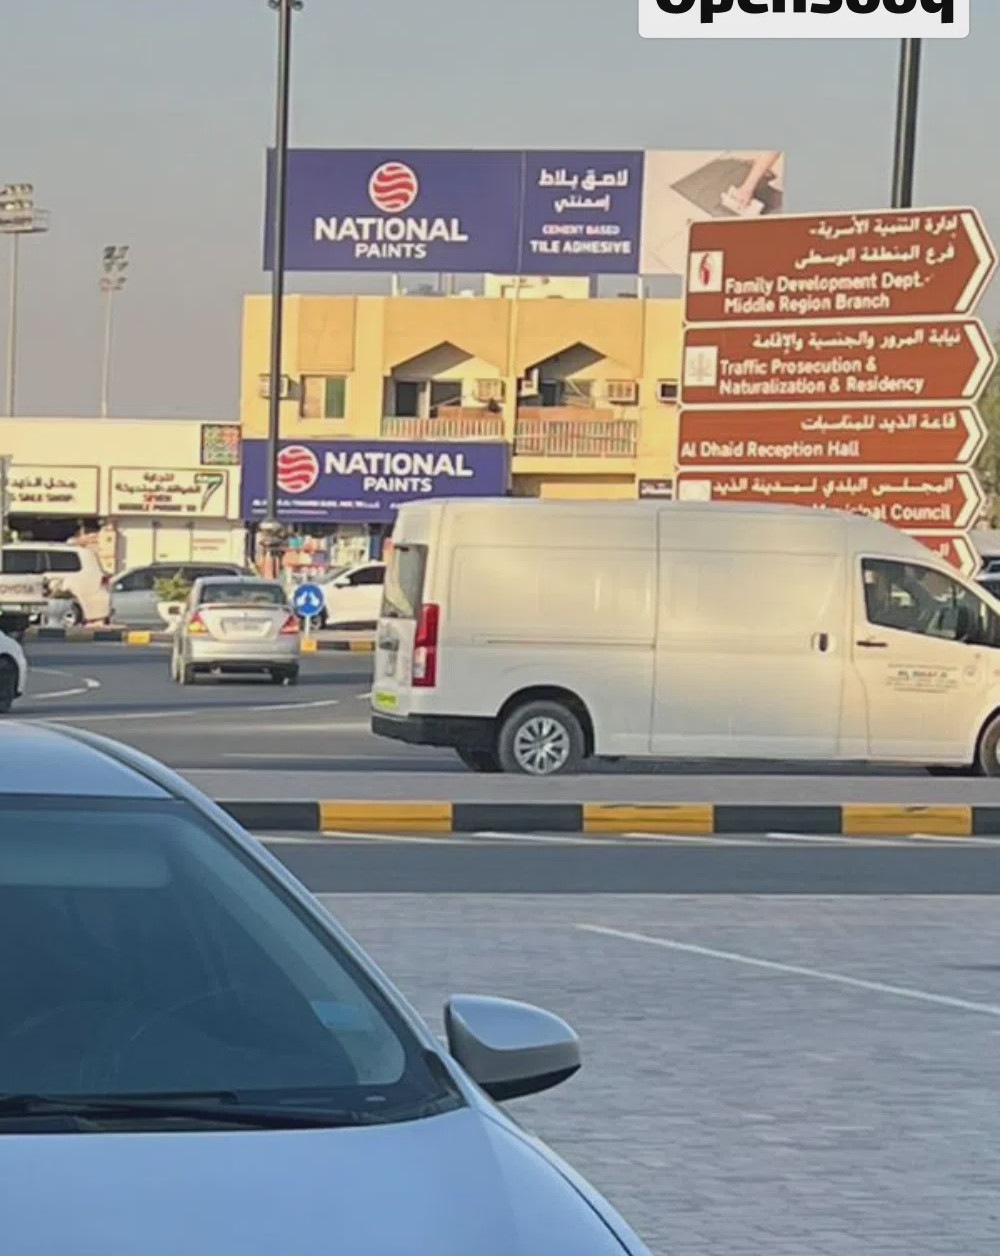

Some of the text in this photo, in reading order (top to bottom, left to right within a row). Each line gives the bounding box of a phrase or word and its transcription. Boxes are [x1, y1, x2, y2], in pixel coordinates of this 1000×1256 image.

[538, 168, 628, 190] لاصق بلاط
[315, 217, 468, 242] NATIONAL
[874, 217, 920, 237] التنمية
[924, 215, 957, 238] إدارة
[355, 242, 427, 259] PAINTS
[530, 240, 631, 254] TILE ADHESIVE
[860, 245, 920, 261] المنطقة
[925, 243, 954, 264] فرع
[725, 277, 774, 295] Family
[777, 272, 878, 293] Development
[724, 293, 889, 314] Middle Region Branch
[809, 331, 874, 349] والجنسية
[880, 329, 923, 349] المرور
[928, 329, 961, 347] نيابة
[720, 355, 877, 375] Traffic Prosecution &
[719, 375, 924, 395] Naturalization & Residency
[800, 412, 957, 433] قاعة الذيد للمناسبات
[681, 440, 859, 459] Al Dhaid Reception Hall
[324, 452, 473, 477] NATIONAL
[363, 477, 432, 492] PAINTS
[713, 477, 748, 496] الذيد
[823, 477, 868, 497] البلدي
[872, 477, 953, 494] المجلس
[891, 503, 951, 520] Council
